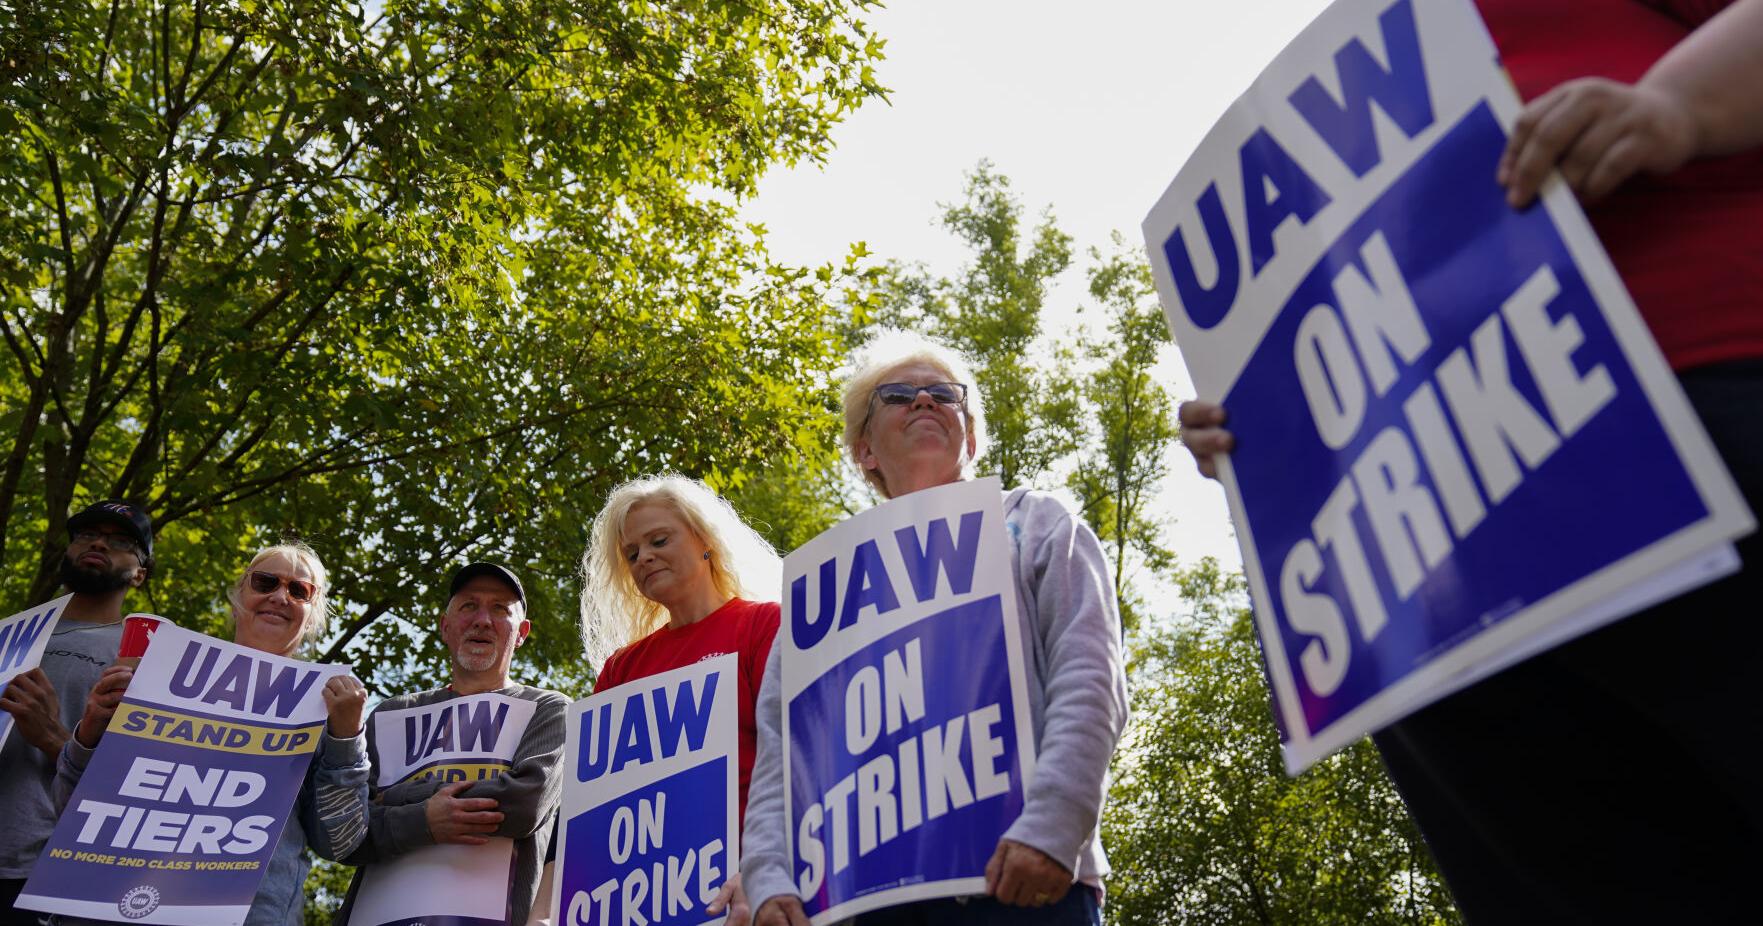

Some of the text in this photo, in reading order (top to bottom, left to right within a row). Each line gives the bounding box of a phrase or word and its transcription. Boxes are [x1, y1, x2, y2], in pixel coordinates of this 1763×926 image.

[1162, 0, 1436, 330] UAW
[1293, 229, 1432, 451] ON
[1280, 264, 1619, 698] STRIKE
[790, 510, 984, 650] UAW
[168, 640, 321, 719] UAW
[845, 637, 926, 756] ON
[122, 710, 310, 752] STAND UP
[405, 701, 510, 767] UAW
[576, 672, 720, 783] UAW
[118, 756, 267, 808] END
[798, 702, 1011, 904] STRIKE
[50, 848, 260, 871] NO MORE 2ND CLASS WORKERS
[76, 799, 276, 855] TIERS
[608, 791, 666, 865] ON
[567, 838, 724, 926] STRIKE
